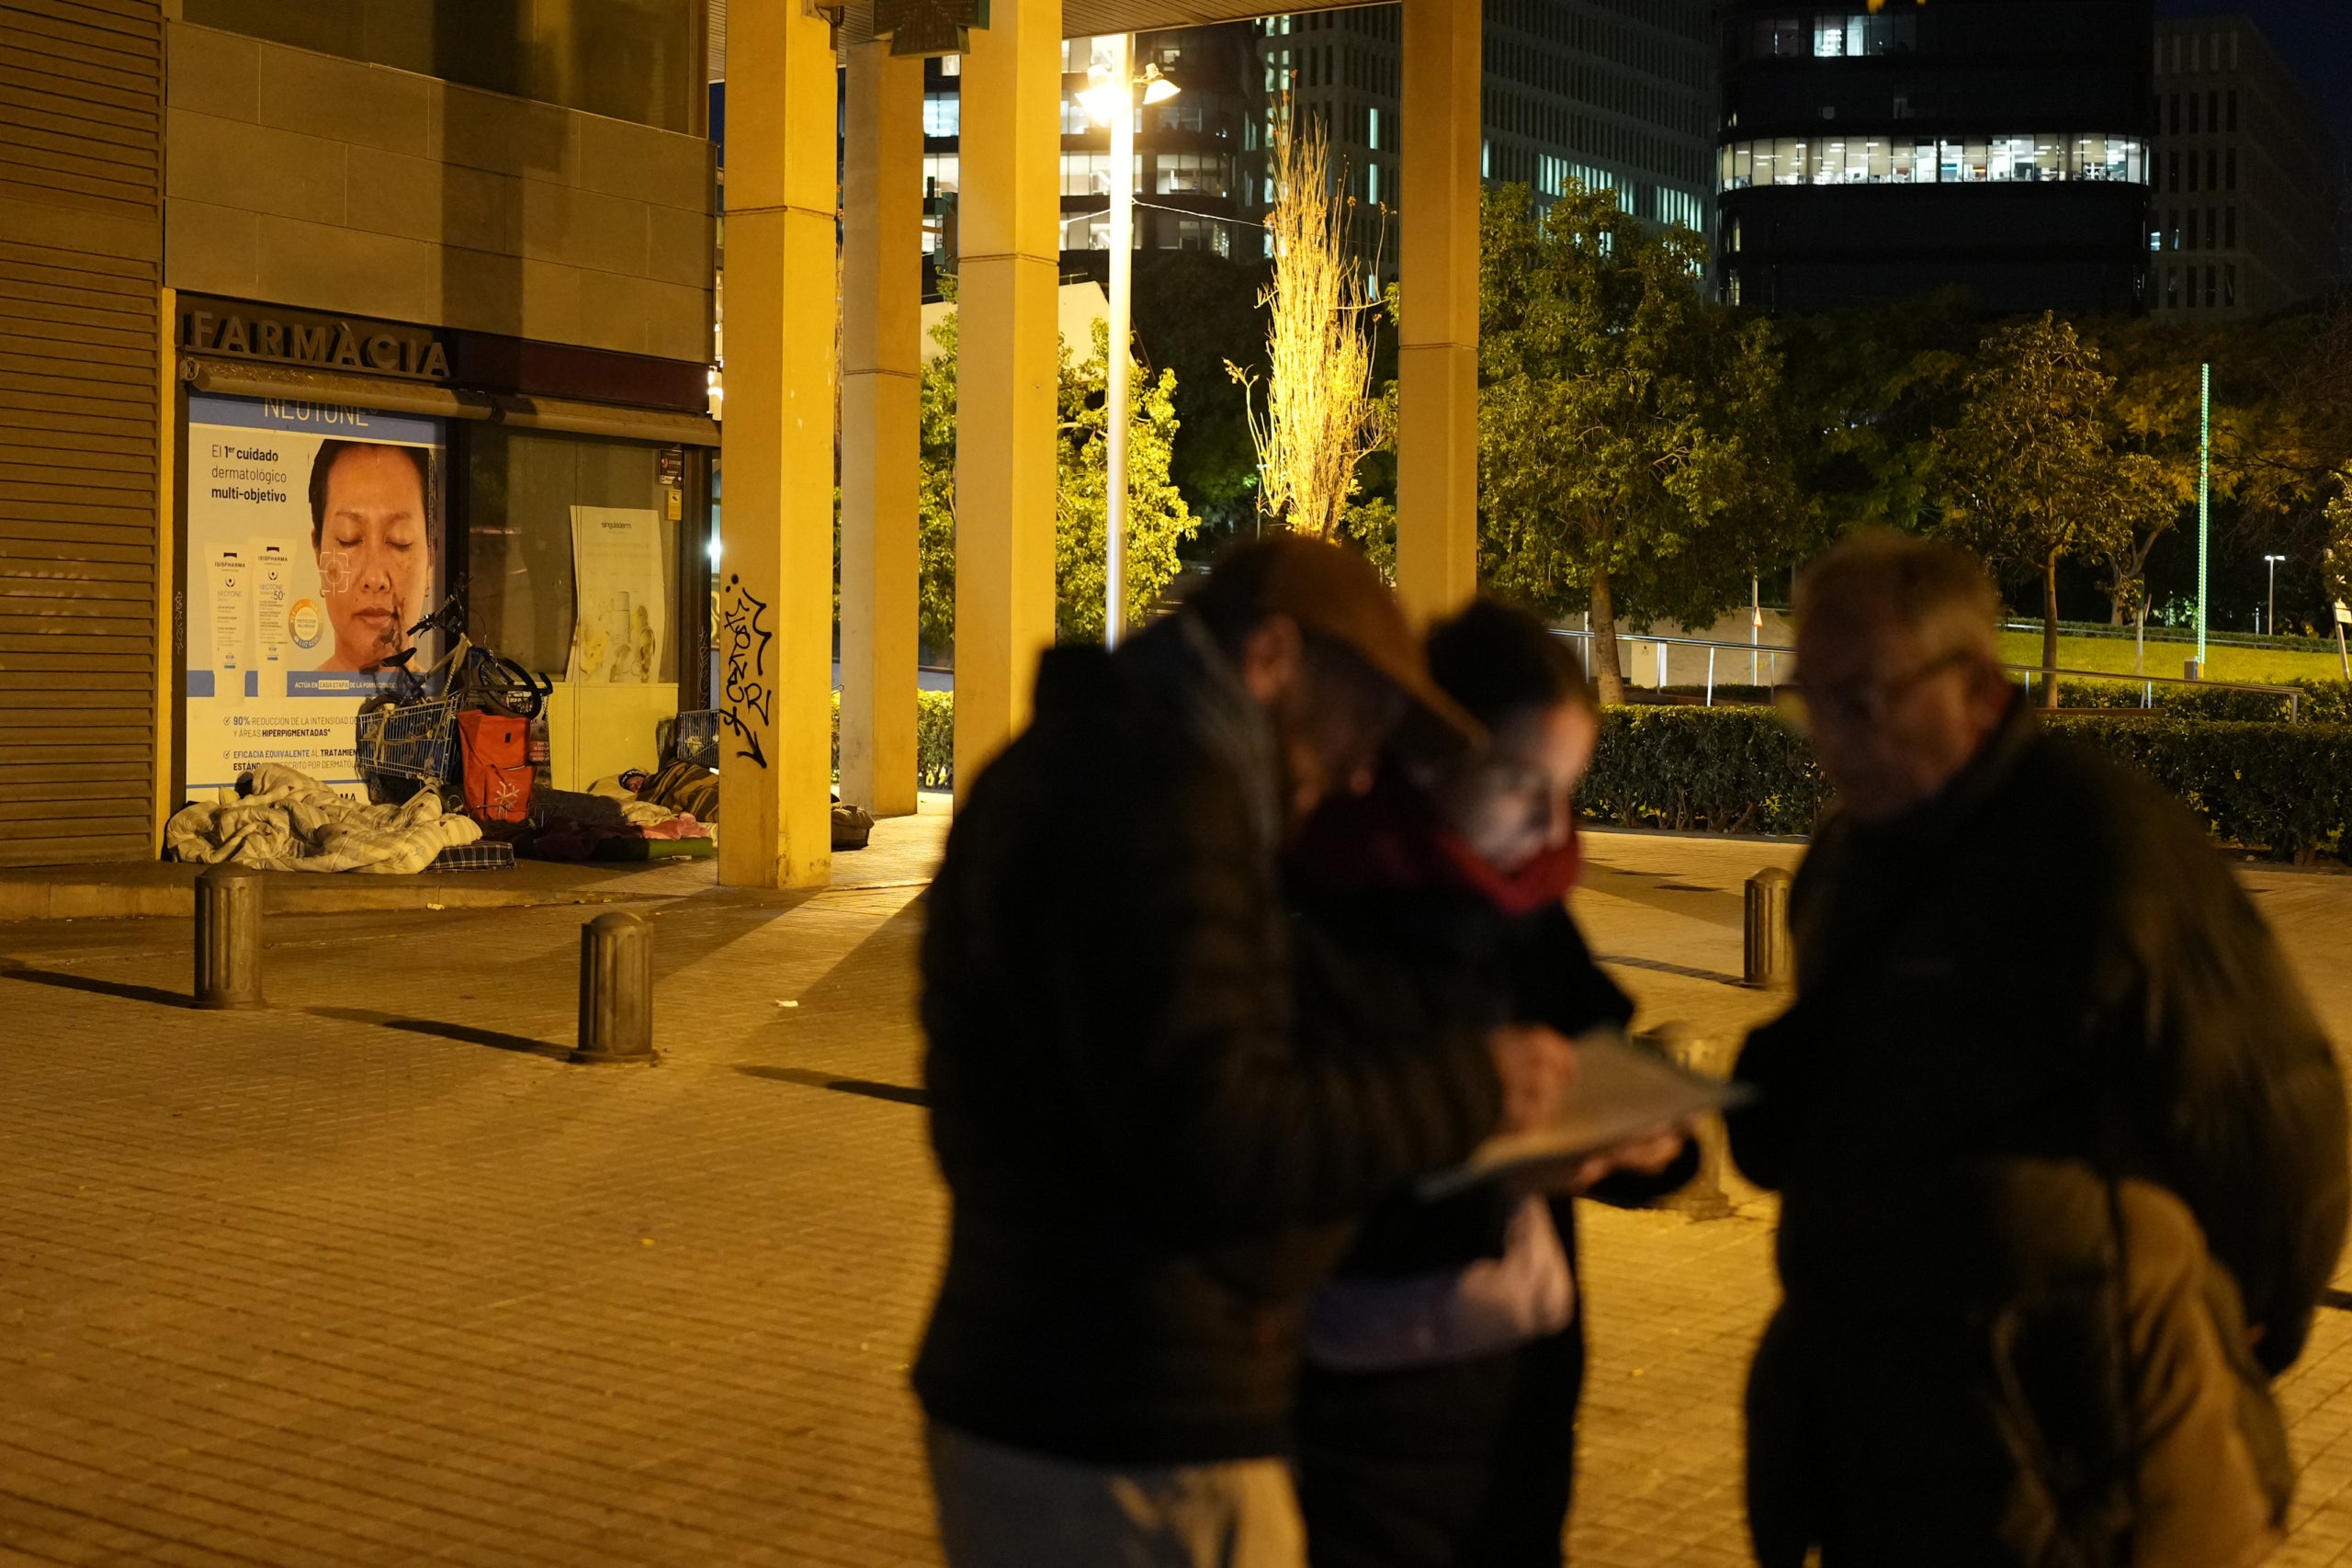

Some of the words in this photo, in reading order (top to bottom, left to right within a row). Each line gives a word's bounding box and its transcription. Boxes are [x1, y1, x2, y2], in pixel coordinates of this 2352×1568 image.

[192, 310, 451, 378] FARMÀCIA
[211, 444, 221, 457] El
[224, 446, 235, 458] 1er
[236, 447, 278, 462] cuidado
[211, 466, 287, 484] dermatológico
[211, 487, 287, 504] multi-objetivo
[233, 716, 251, 726] 90%
[290, 716, 300, 726] DE
[300, 716, 310, 725] LA
[311, 716, 349, 725] INTENSIDAD
[233, 750, 264, 759] EFICACIA
[265, 750, 310, 759] EQUIVALENTE
[311, 750, 320, 758] AL
[308, 761, 321, 769] POR
[322, 759, 356, 769] DERMATÓL
